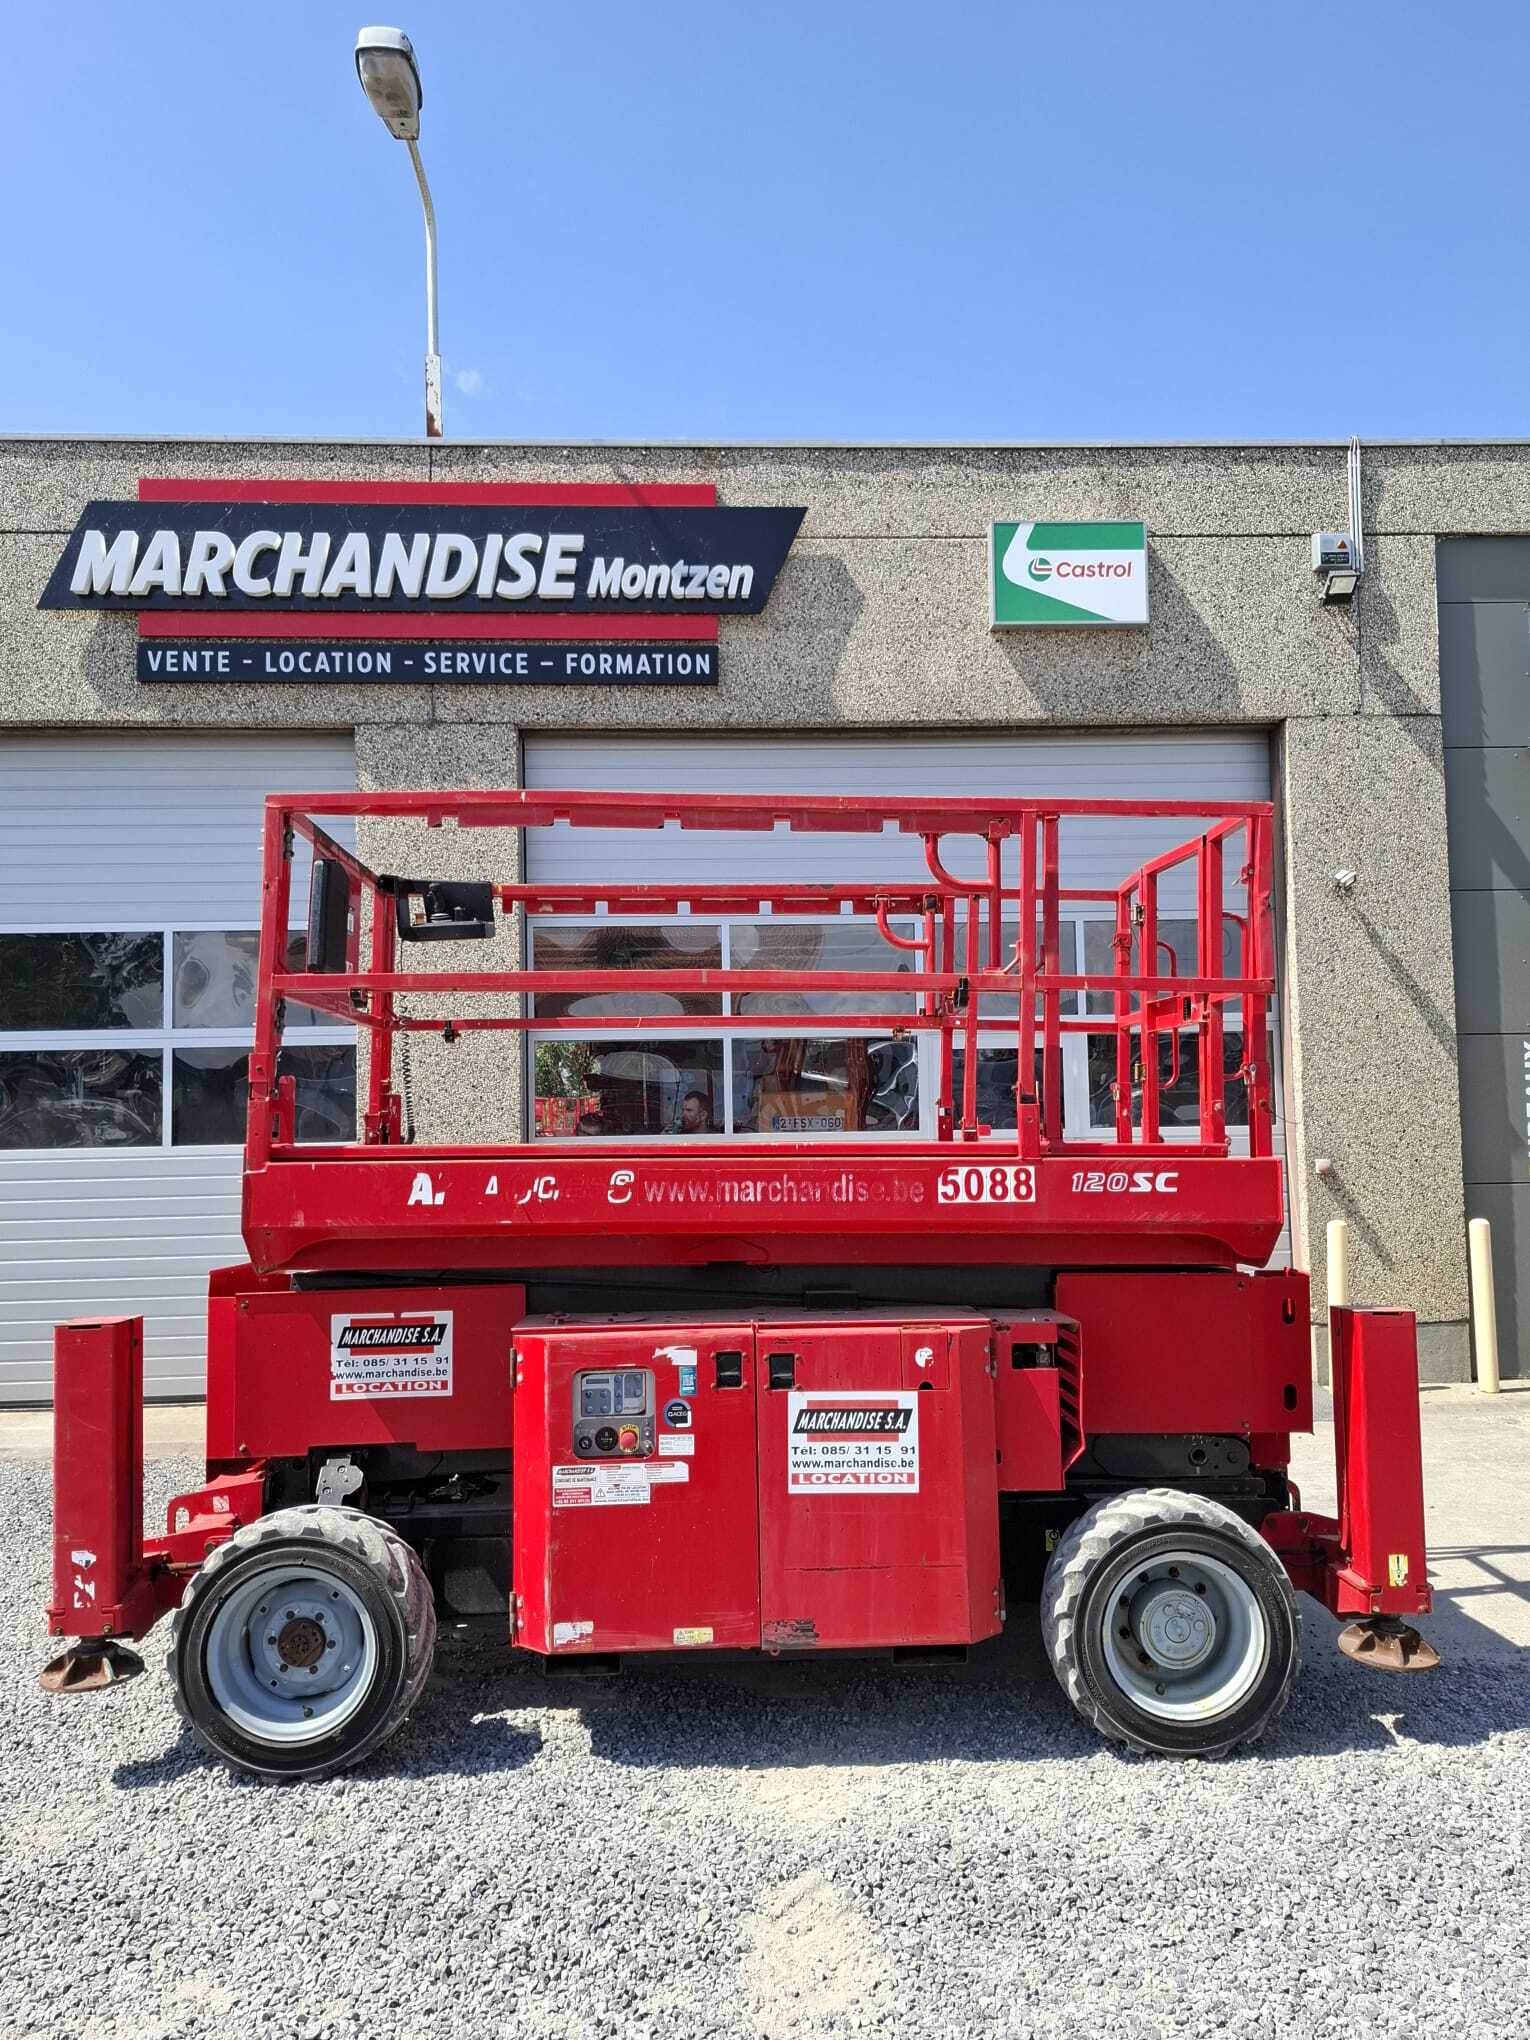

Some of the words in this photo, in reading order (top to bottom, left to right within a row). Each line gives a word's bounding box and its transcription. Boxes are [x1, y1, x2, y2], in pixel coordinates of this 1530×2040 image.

[69, 529, 585, 600] MARCHANDISE
[586, 555, 755, 600] Montzen
[1056, 560, 1132, 579] Castrol
[146, 650, 231, 674] VENTE
[265, 651, 392, 674] LOCATION
[424, 651, 530, 674] SERVICE
[565, 652, 712, 675] FORMATION
[643, 1174, 925, 1204] www.marchandise.be
[940, 1167, 1034, 1202] 5088
[341, 1327, 422, 1345] MARCHANDISE
[421, 1327, 441, 1343] S.A.
[393, 1358, 407, 1366] 31
[414, 1357, 428, 1365] 15
[435, 1356, 449, 1364] 91
[336, 1367, 448, 1380] www.marchandise.be
[341, 1380, 442, 1393] LOCATION
[797, 1411, 884, 1430] MARCHANDISE
[884, 1411, 907, 1430] S.A.
[855, 1446, 870, 1455] 31
[876, 1446, 892, 1455] 15
[900, 1446, 916, 1455] 91
[791, 1457, 915, 1469] www.marchandise.be
[798, 1473, 909, 1484] LOCATION
